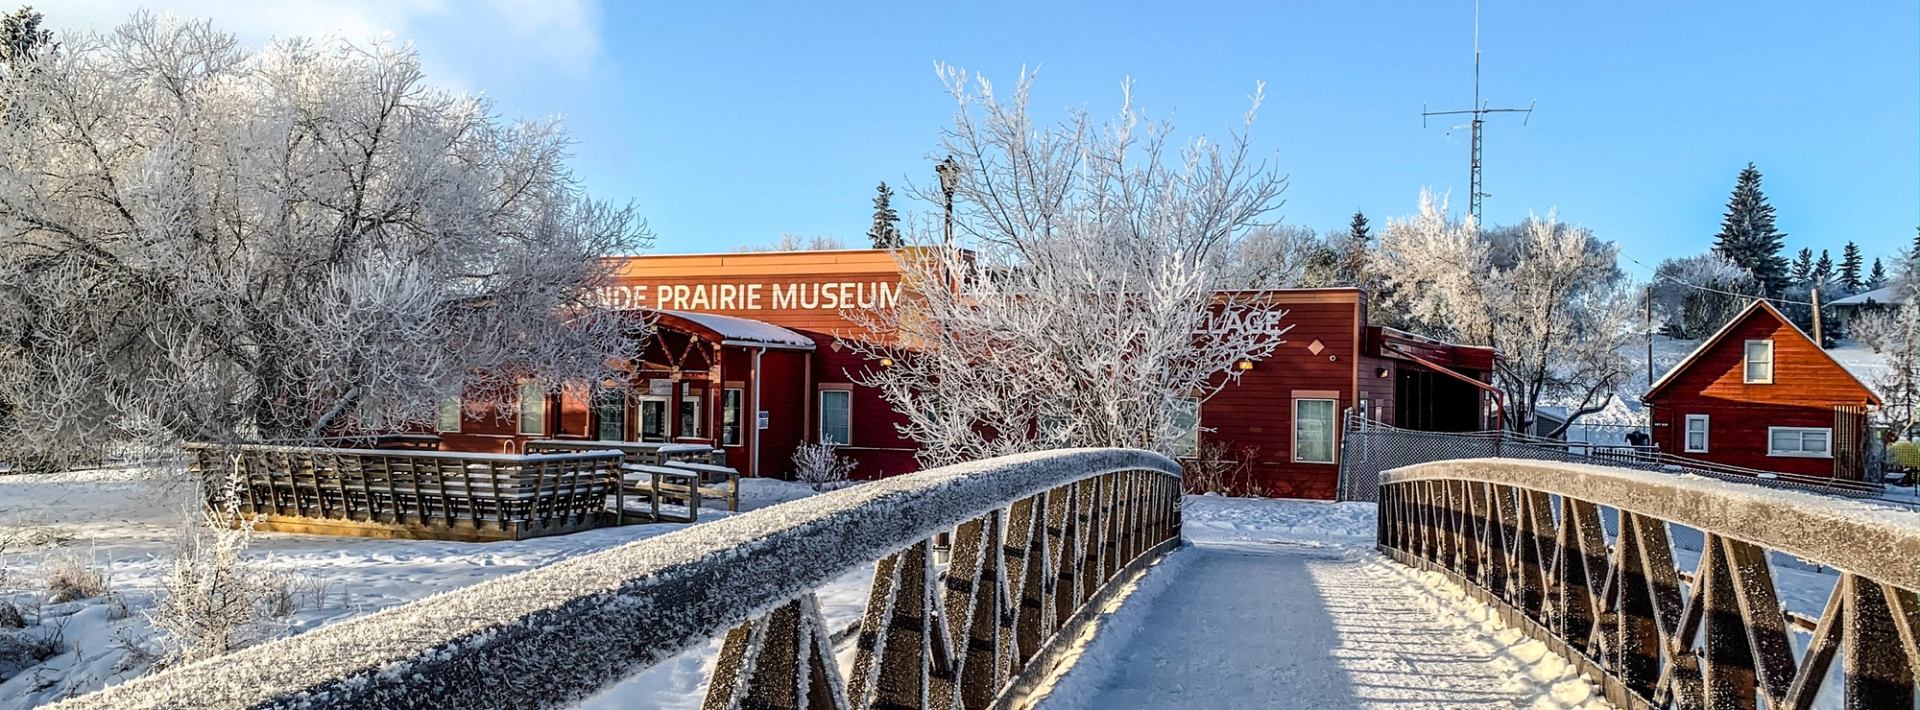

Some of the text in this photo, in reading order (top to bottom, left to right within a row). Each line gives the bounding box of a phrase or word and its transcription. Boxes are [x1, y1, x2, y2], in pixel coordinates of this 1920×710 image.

[559, 281, 902, 310] NDE PRAIRIE MUSEUM
